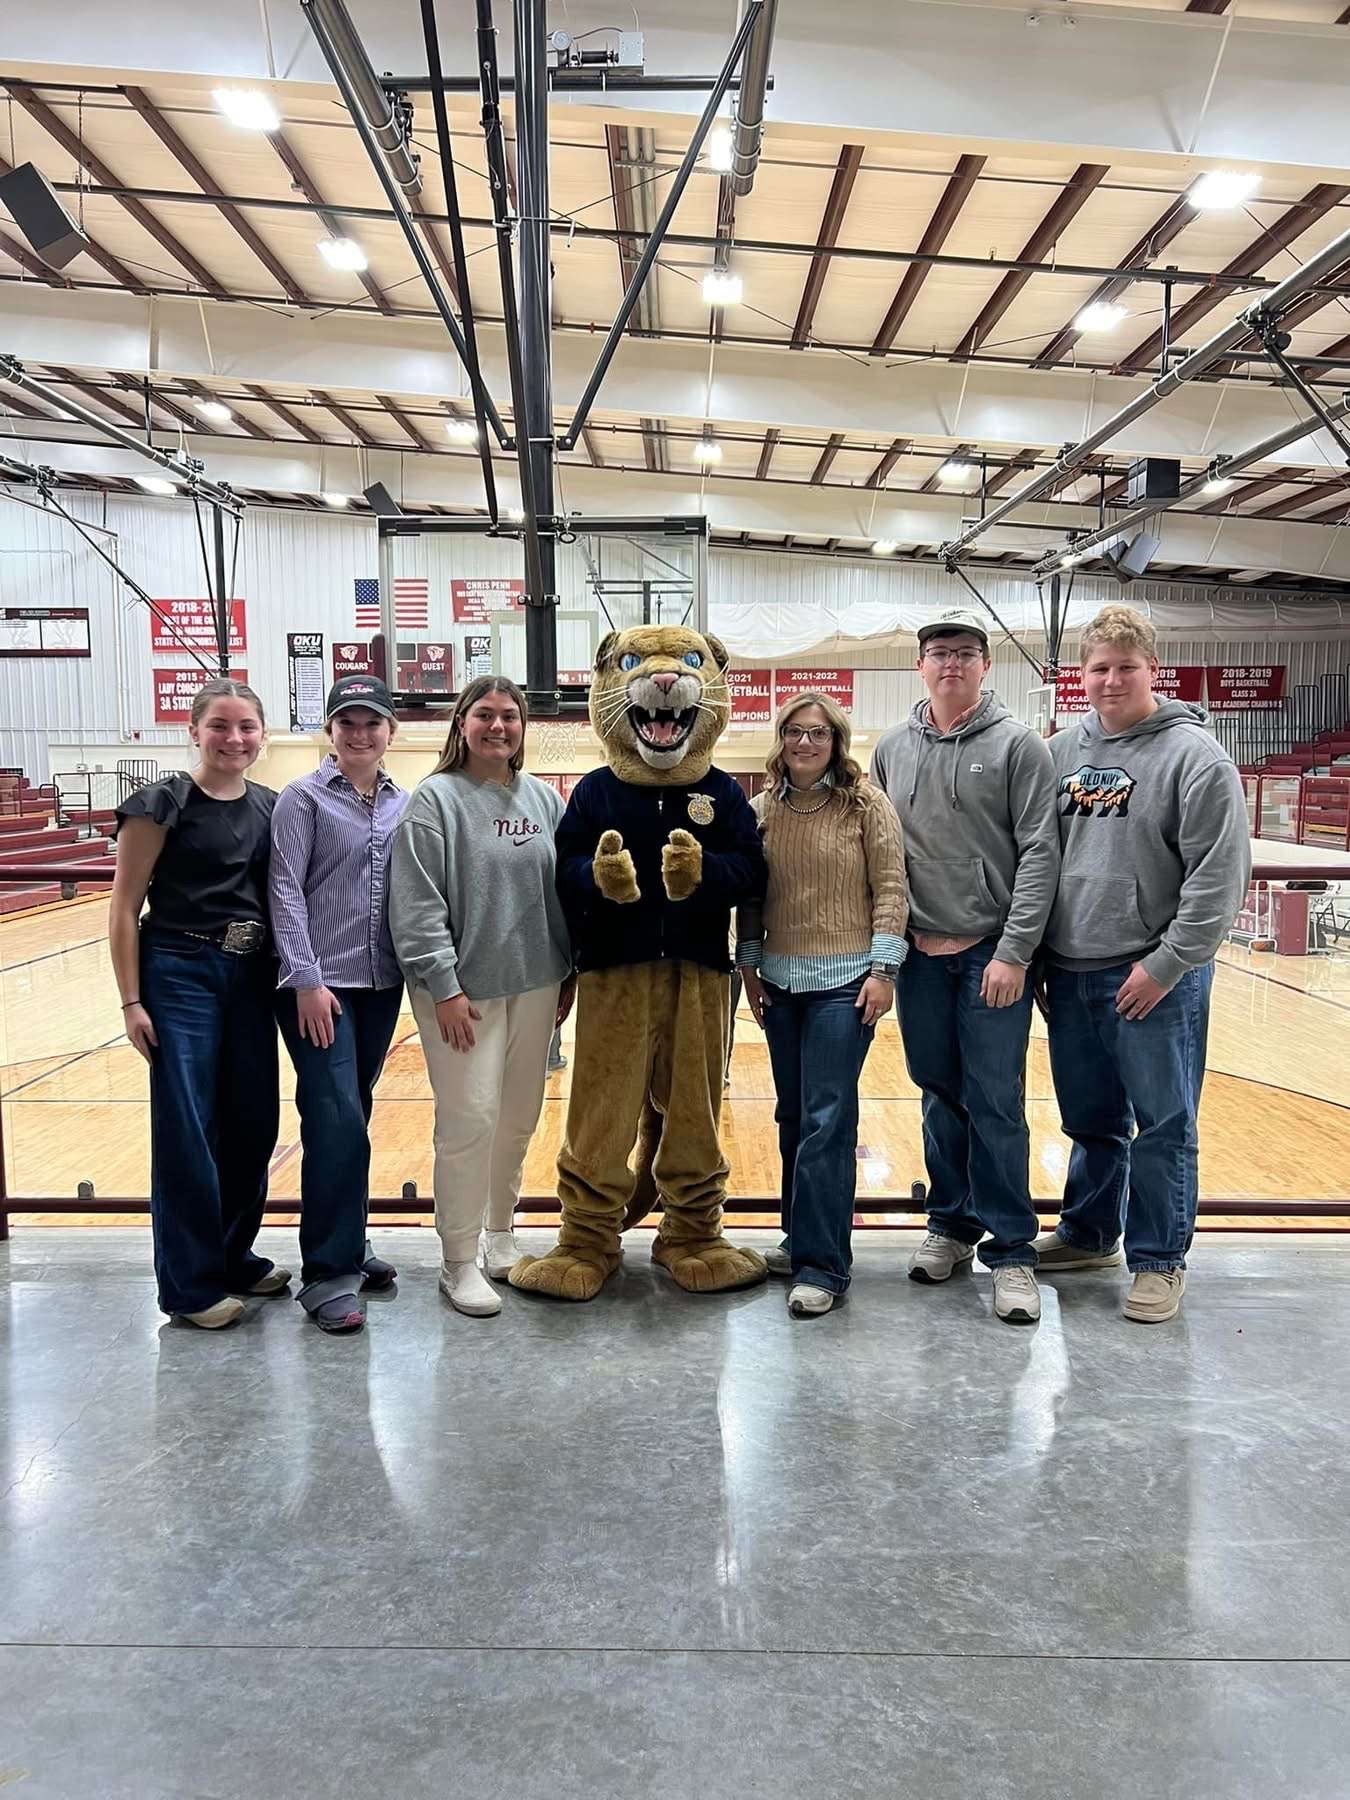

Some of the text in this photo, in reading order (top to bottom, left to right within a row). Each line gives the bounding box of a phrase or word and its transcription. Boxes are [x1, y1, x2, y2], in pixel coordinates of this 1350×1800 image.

[466, 581, 511, 590] CHRIS PENN
[471, 637, 492, 648] OK
[334, 662, 369, 671] COUGARS
[421, 662, 446, 671] GUEST
[176, 672, 198, 682] 2015
[791, 672, 838, 681] 2021-2022
[158, 682, 175, 694] LADY
[1163, 679, 1181, 688] TRACK
[1220, 679, 1270, 688] BOYS BASKETBALL
[776, 685, 853, 693] BOYS BASKETBALL
[1231, 689, 1248, 698] CLASS
[160, 696, 172, 711] 3A
[1080, 773, 1101, 786] OLD
